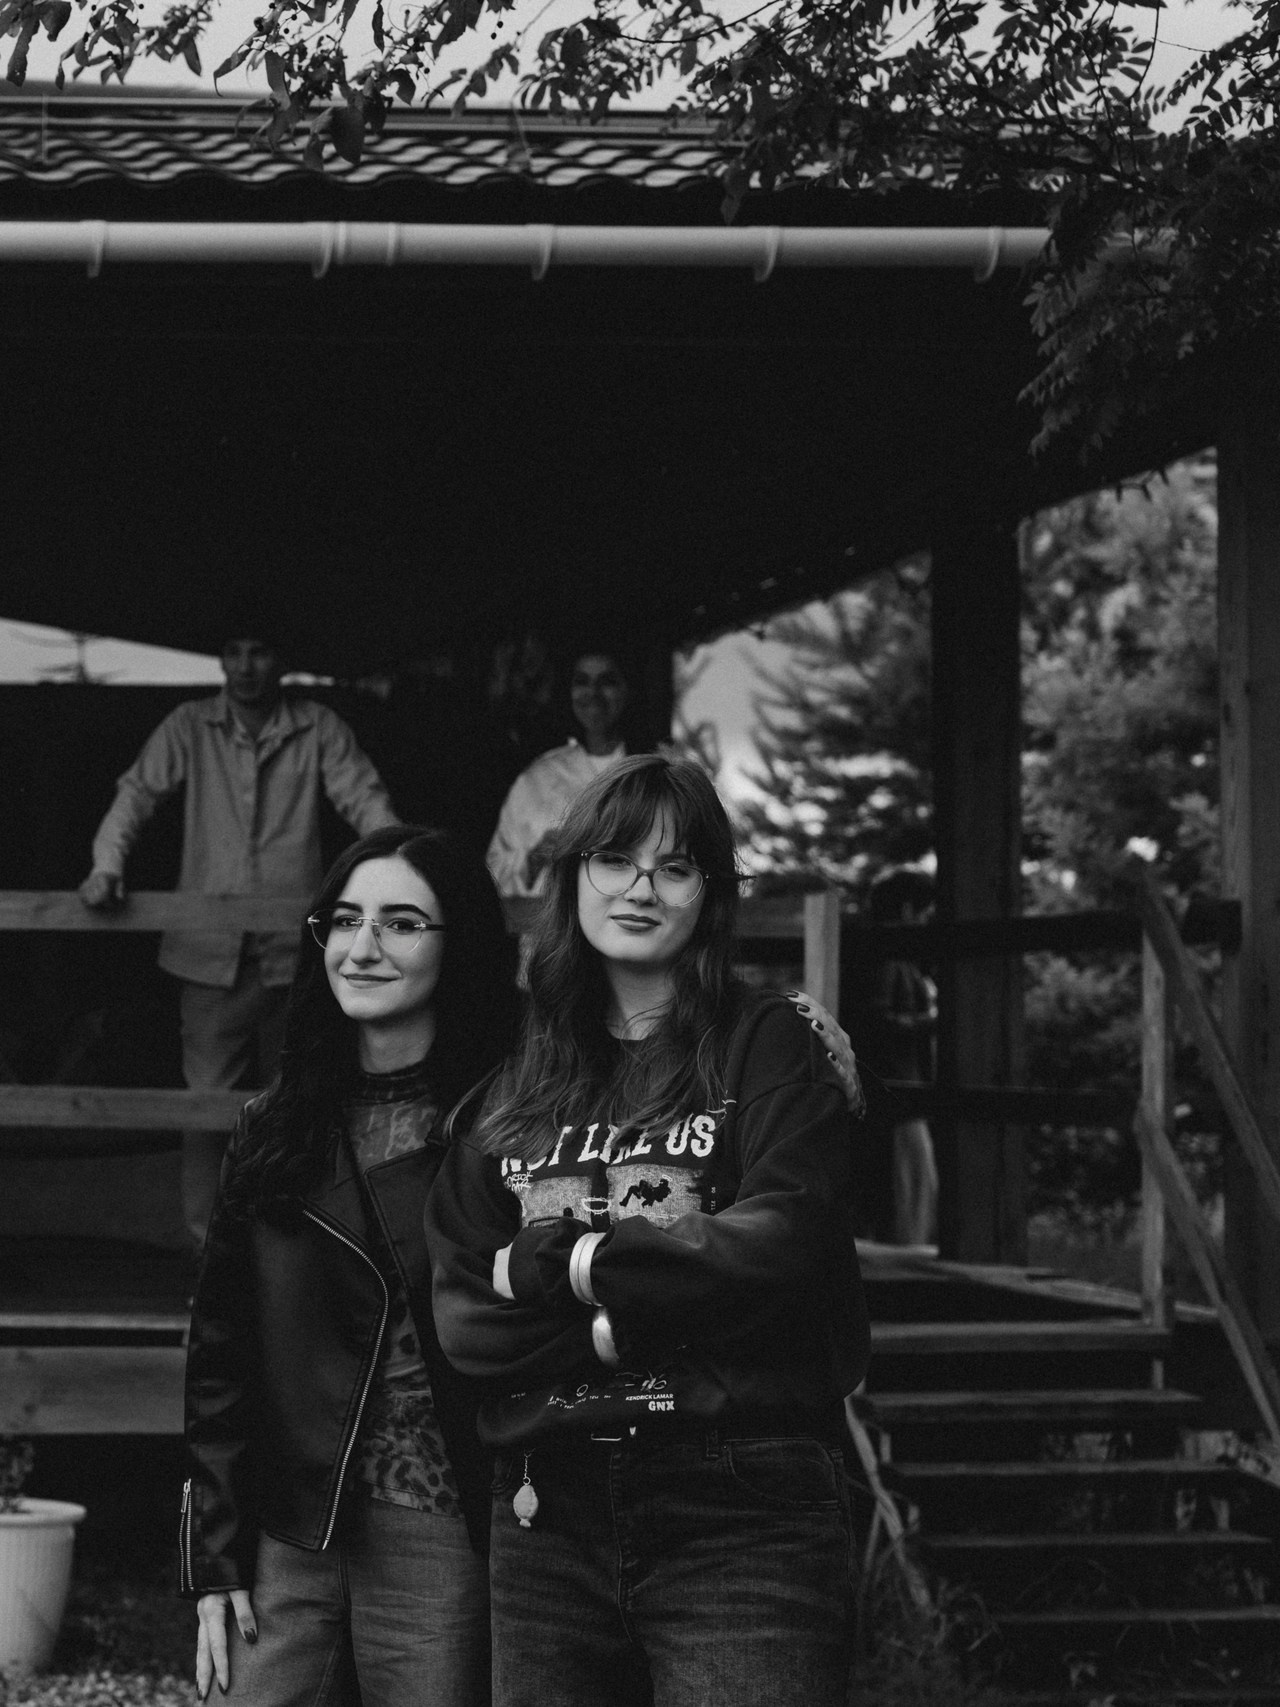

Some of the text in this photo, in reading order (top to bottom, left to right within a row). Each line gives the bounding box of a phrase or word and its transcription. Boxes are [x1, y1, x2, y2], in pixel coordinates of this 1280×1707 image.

[501, 1126, 573, 1177] NT
[664, 1112, 716, 1158] US
[648, 1400, 675, 1411] GNX
